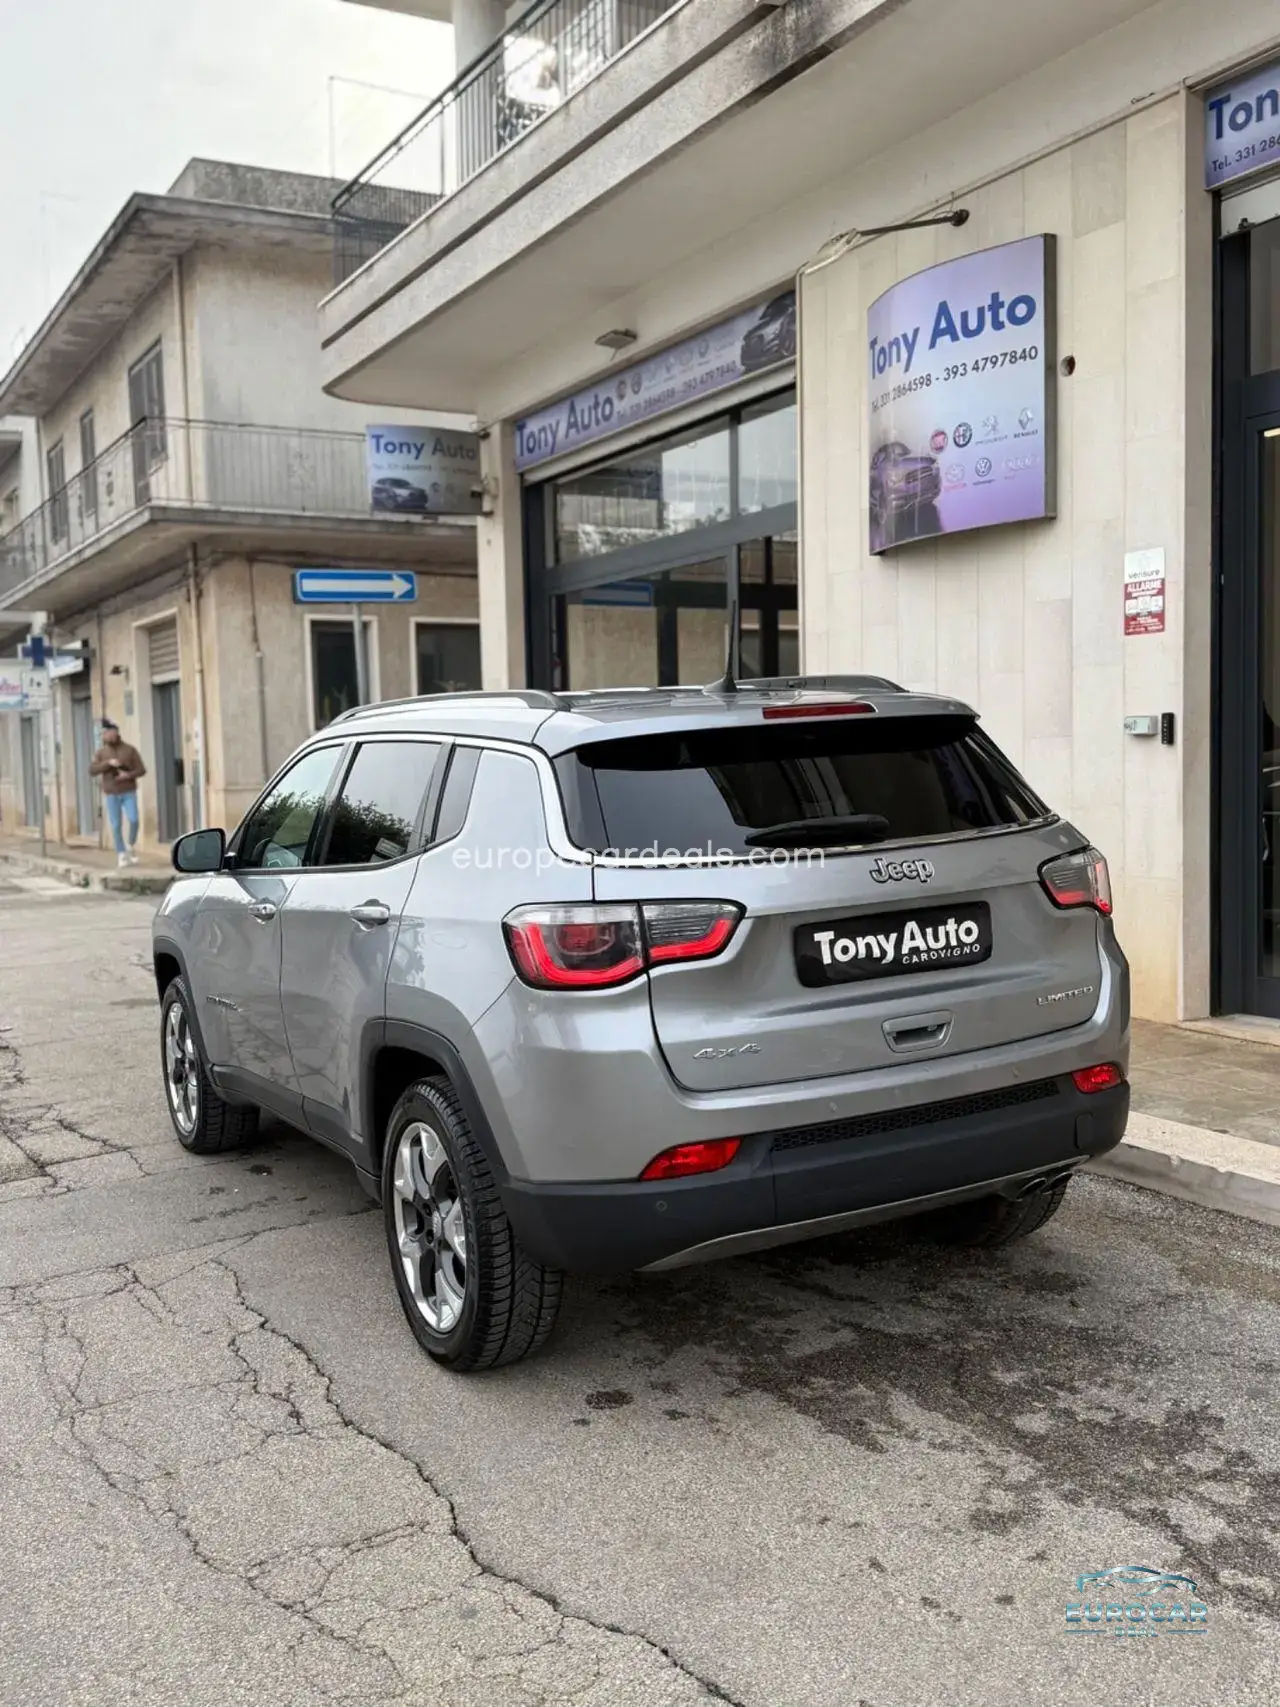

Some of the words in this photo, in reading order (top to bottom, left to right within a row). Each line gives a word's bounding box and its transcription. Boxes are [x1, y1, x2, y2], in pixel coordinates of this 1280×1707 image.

[1212, 155, 1231, 172] Tel.
[1235, 144, 1256, 162] 331
[869, 326, 920, 380] Tony
[928, 291, 1037, 351] Auto
[892, 372, 932, 401] 2864598
[943, 362, 968, 382] 393
[971, 345, 1039, 373] 4797840
[515, 420, 560, 457] Tony
[565, 394, 614, 440] Auto
[372, 435, 425, 461] Tony
[432, 437, 476, 461] Auto
[869, 857, 935, 883] Jeep
[902, 943, 980, 964] CAROVIGNO
[1036, 985, 1094, 1006] LIMITED
